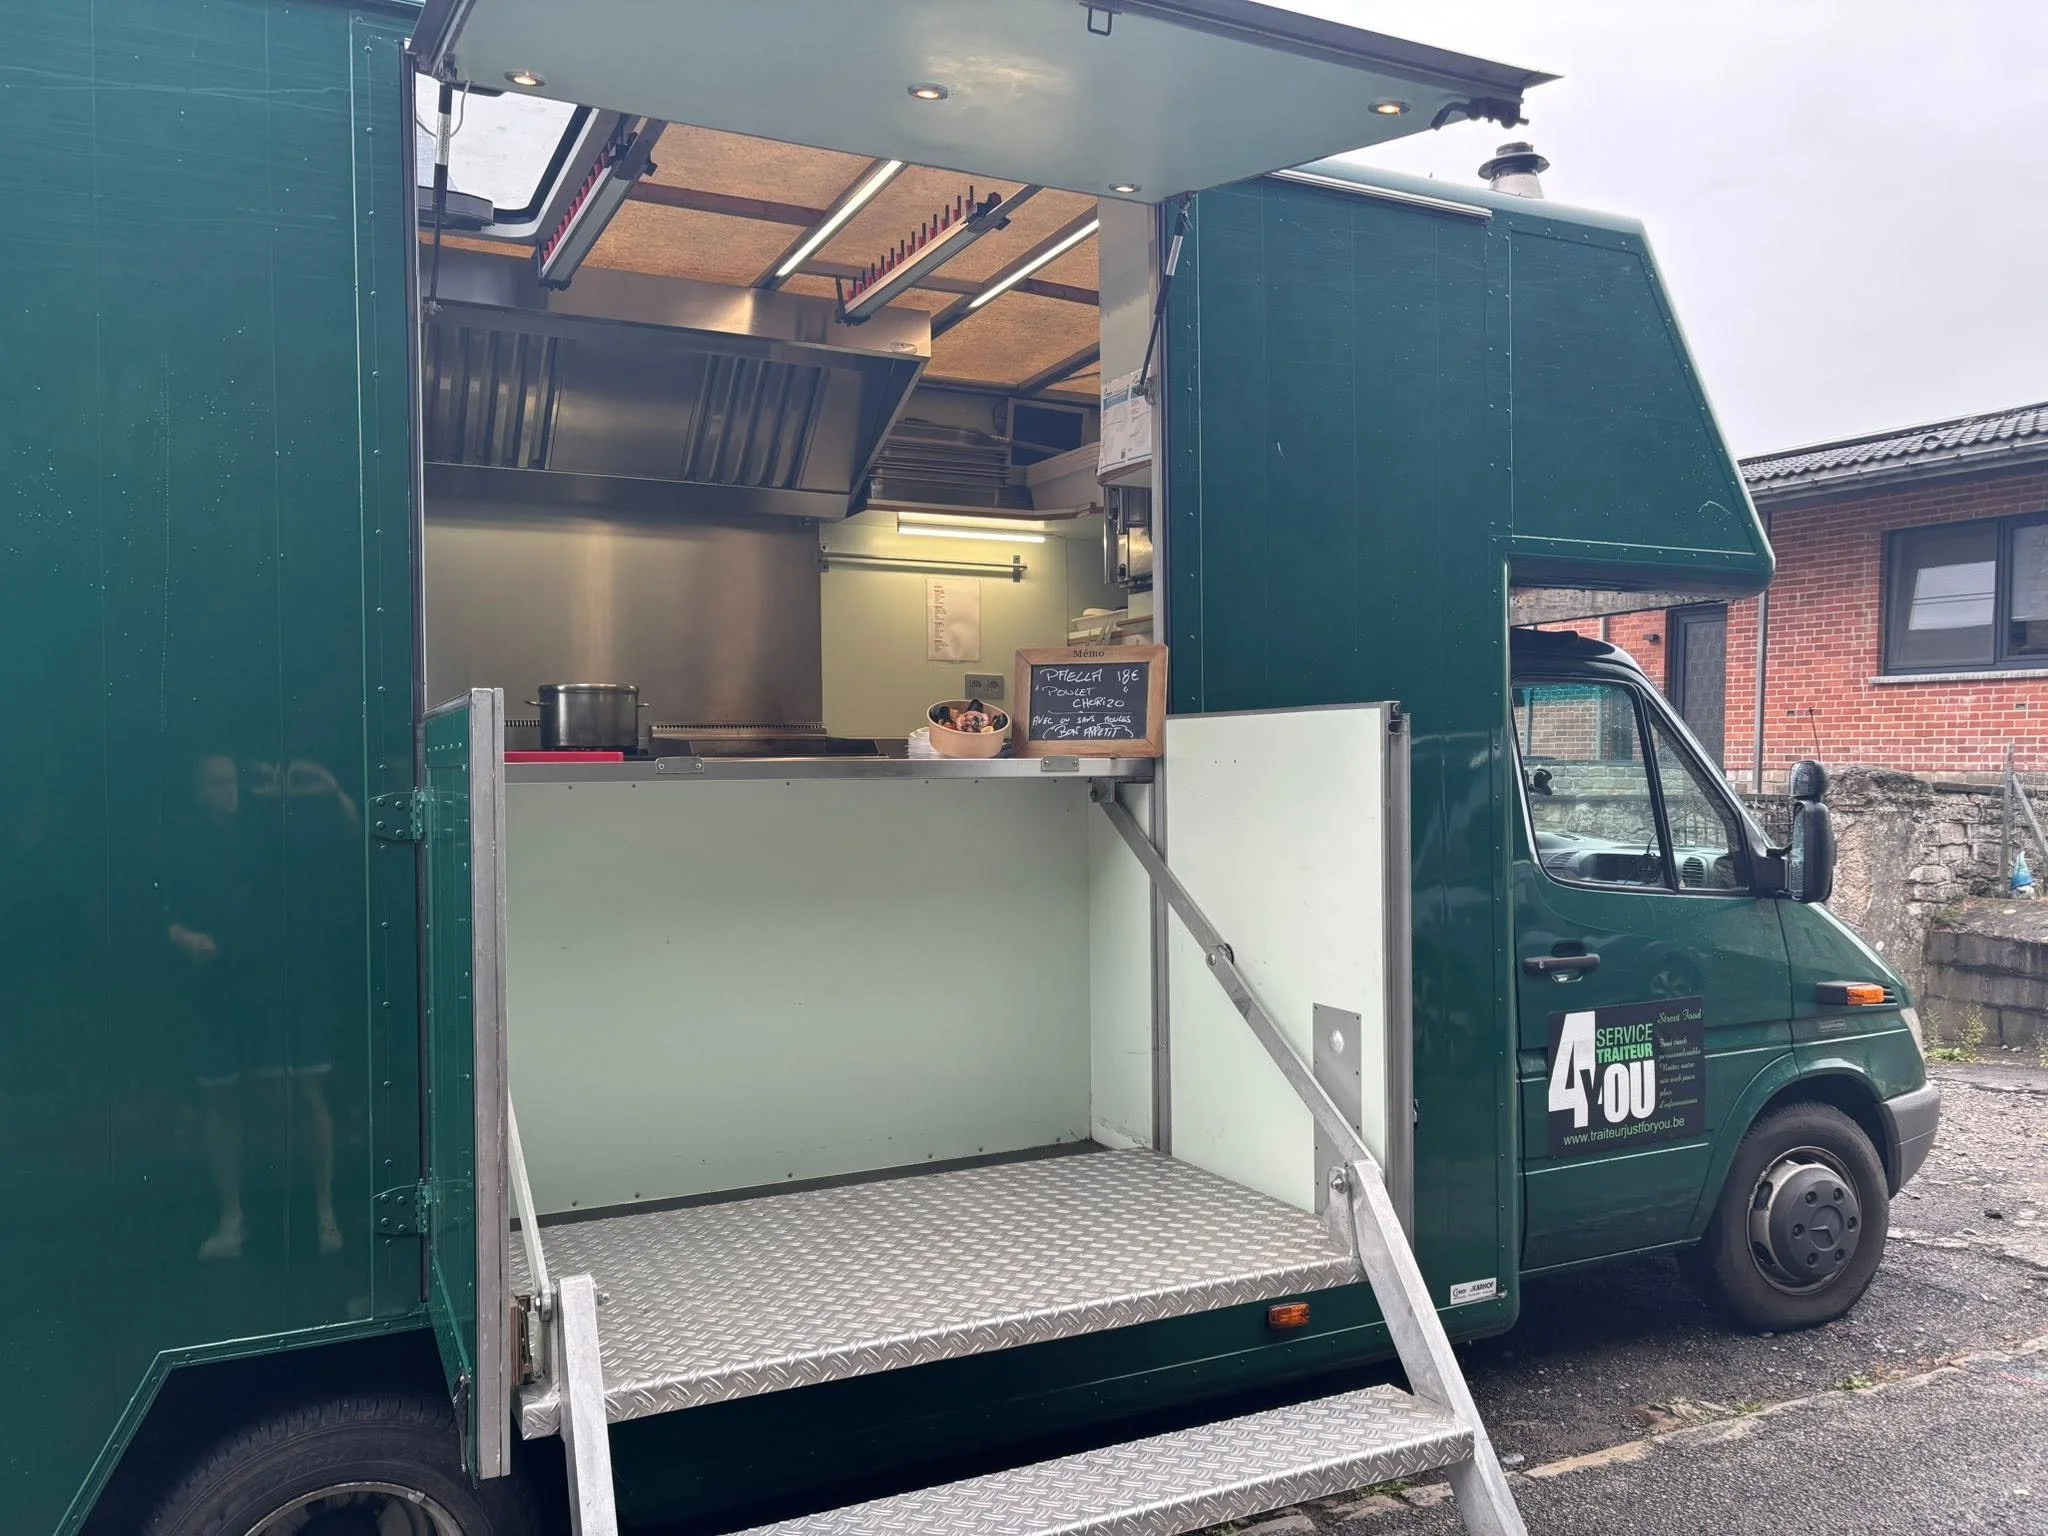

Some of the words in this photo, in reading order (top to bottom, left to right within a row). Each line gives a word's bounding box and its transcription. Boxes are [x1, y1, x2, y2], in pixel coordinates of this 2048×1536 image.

[1073, 648, 1105, 658] Mémo
[1040, 668, 1102, 682] PAELLA
[1117, 669, 1140, 684] 18€
[1042, 686, 1096, 696] POULET
[1032, 714, 1054, 726] AVEC
[1054, 725, 1081, 738] BON
[1596, 1023, 1654, 1047] SERVICE
[1596, 1042, 1654, 1064] TRAITEUR
[1563, 1116, 1686, 1146] www.traiteurjustforyou.be
